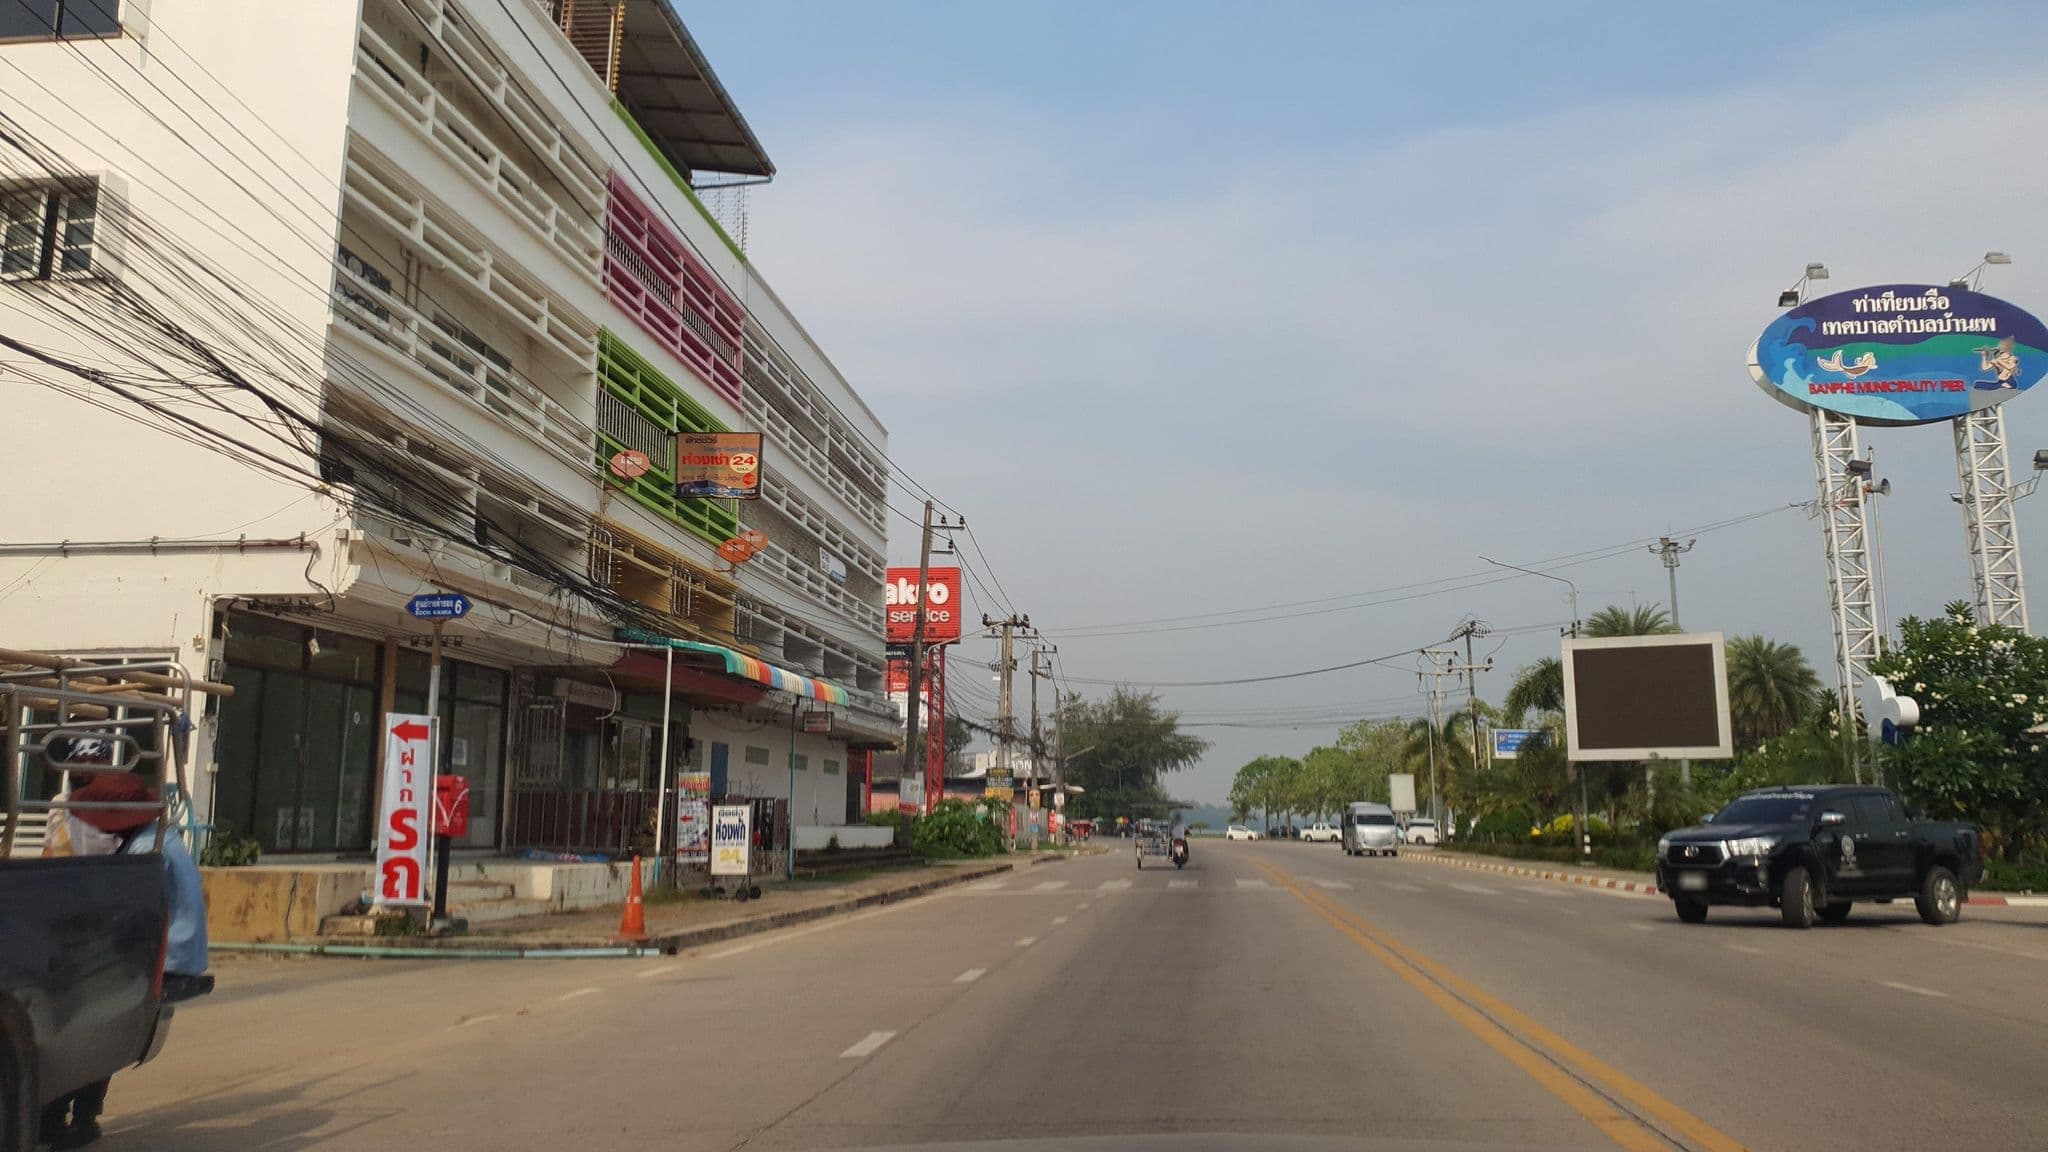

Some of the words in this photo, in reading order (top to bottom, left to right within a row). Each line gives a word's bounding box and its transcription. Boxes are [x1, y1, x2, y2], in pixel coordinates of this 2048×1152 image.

[1853, 287, 1950, 313] ท่าเทียบเรือ
[1822, 311, 1997, 336] เทศบาลตำบลบ้านเพ
[1809, 381, 1855, 395] BANPHE
[1857, 380, 1938, 394] MUNICIPALITY
[1940, 380, 1965, 393] PIER
[732, 455, 756, 466] 24
[454, 600, 463, 614] 6
[890, 608, 950, 623] serice
[720, 848, 739, 862] 24
